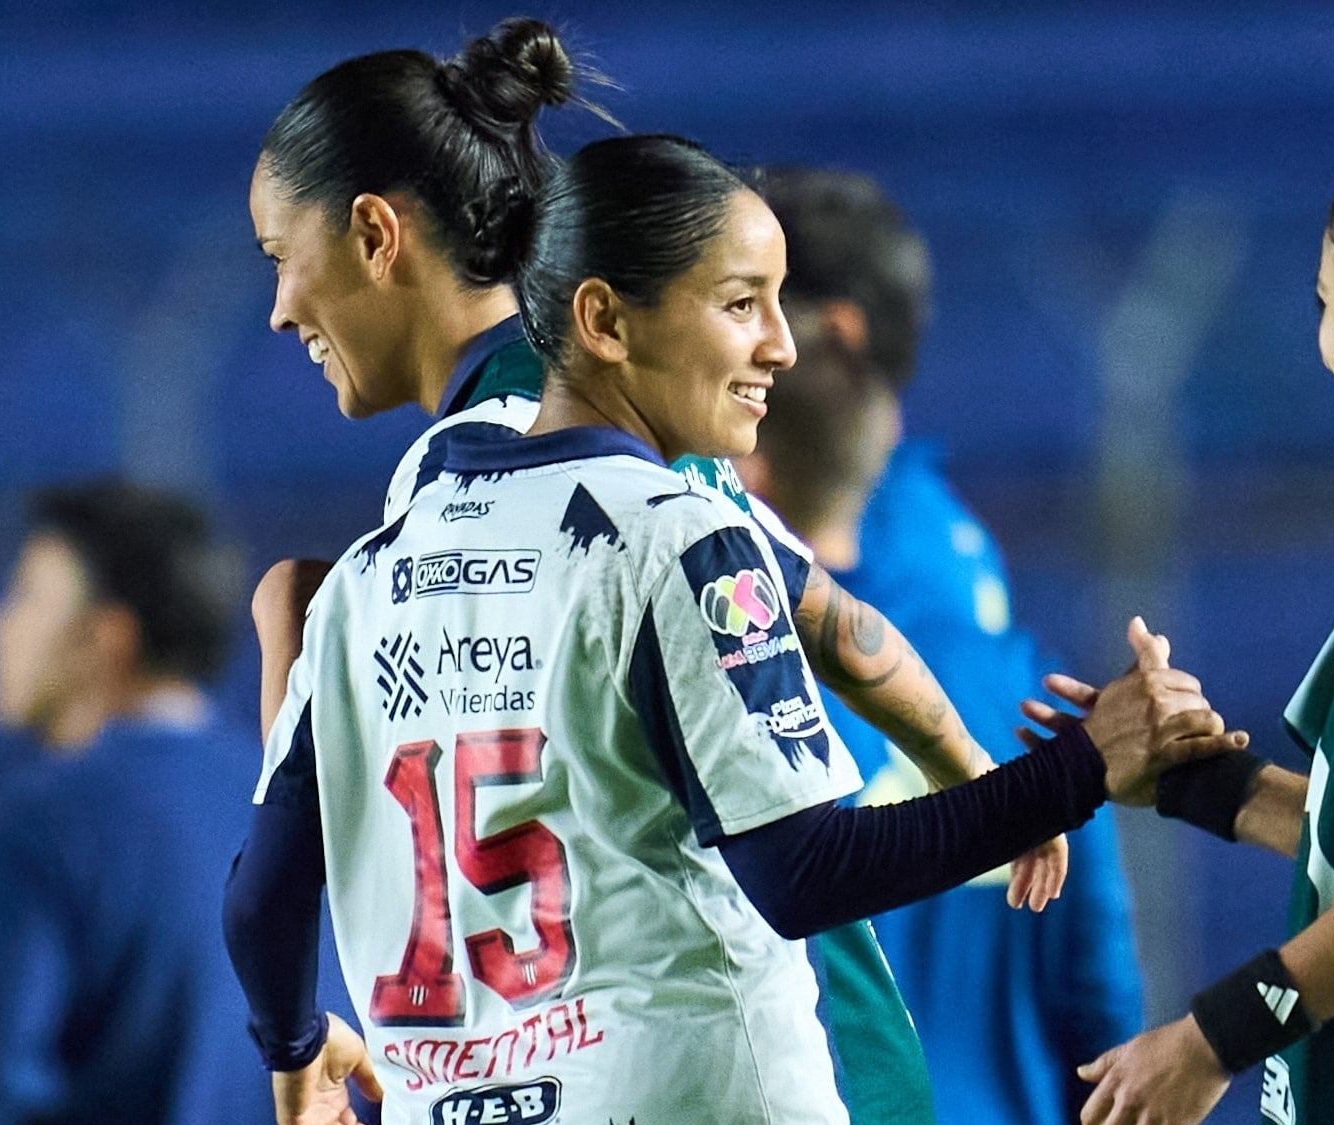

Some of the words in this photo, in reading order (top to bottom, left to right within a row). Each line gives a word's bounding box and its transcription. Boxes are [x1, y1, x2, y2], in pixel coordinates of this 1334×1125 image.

[436, 625, 534, 684] Areya
[369, 727, 577, 1027] 15
[384, 998, 604, 1090] SIMENTAL
